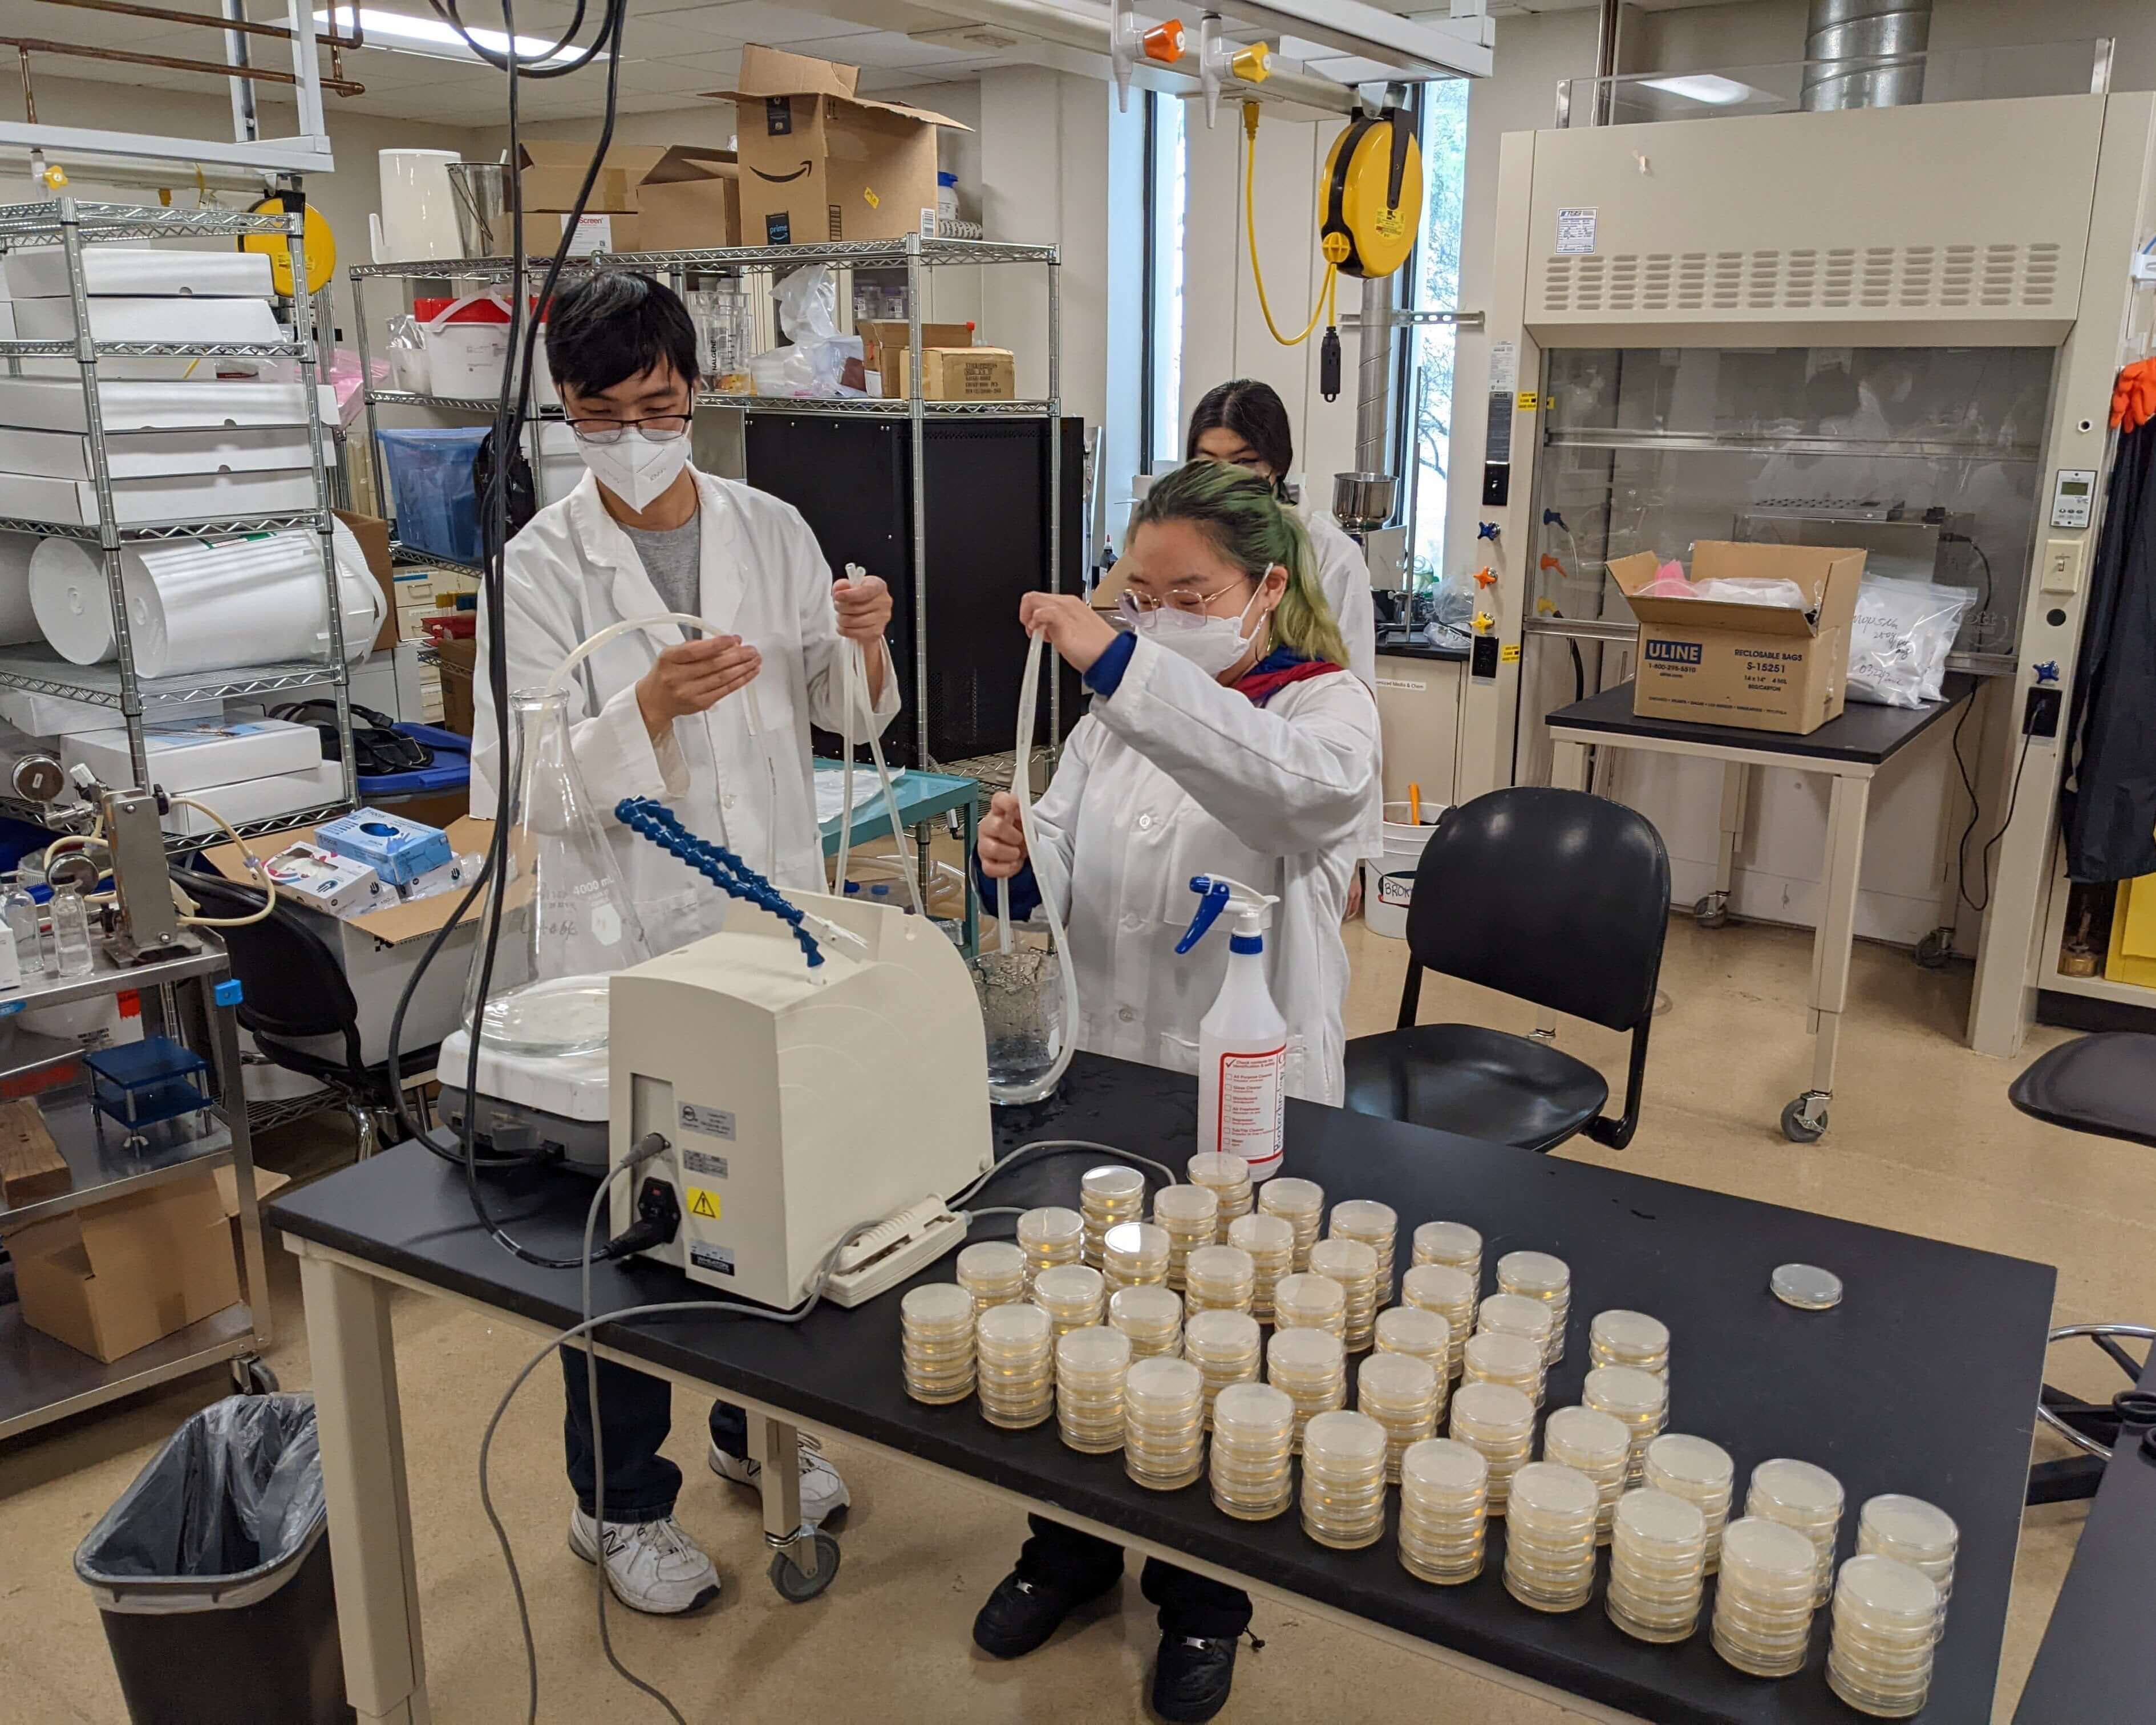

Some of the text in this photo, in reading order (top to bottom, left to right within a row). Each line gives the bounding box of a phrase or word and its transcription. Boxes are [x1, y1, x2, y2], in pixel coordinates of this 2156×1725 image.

[770, 225, 788, 234] prime
[1649, 643, 1699, 661] ULINE
[1734, 649, 1780, 659] RECLOSABLE
[1648, 663, 1696, 673] 1-800-295-5510
[1747, 662, 1785, 673] S-15251
[573, 880, 599, 895] 4000
[1385, 882, 1411, 898] BROK
